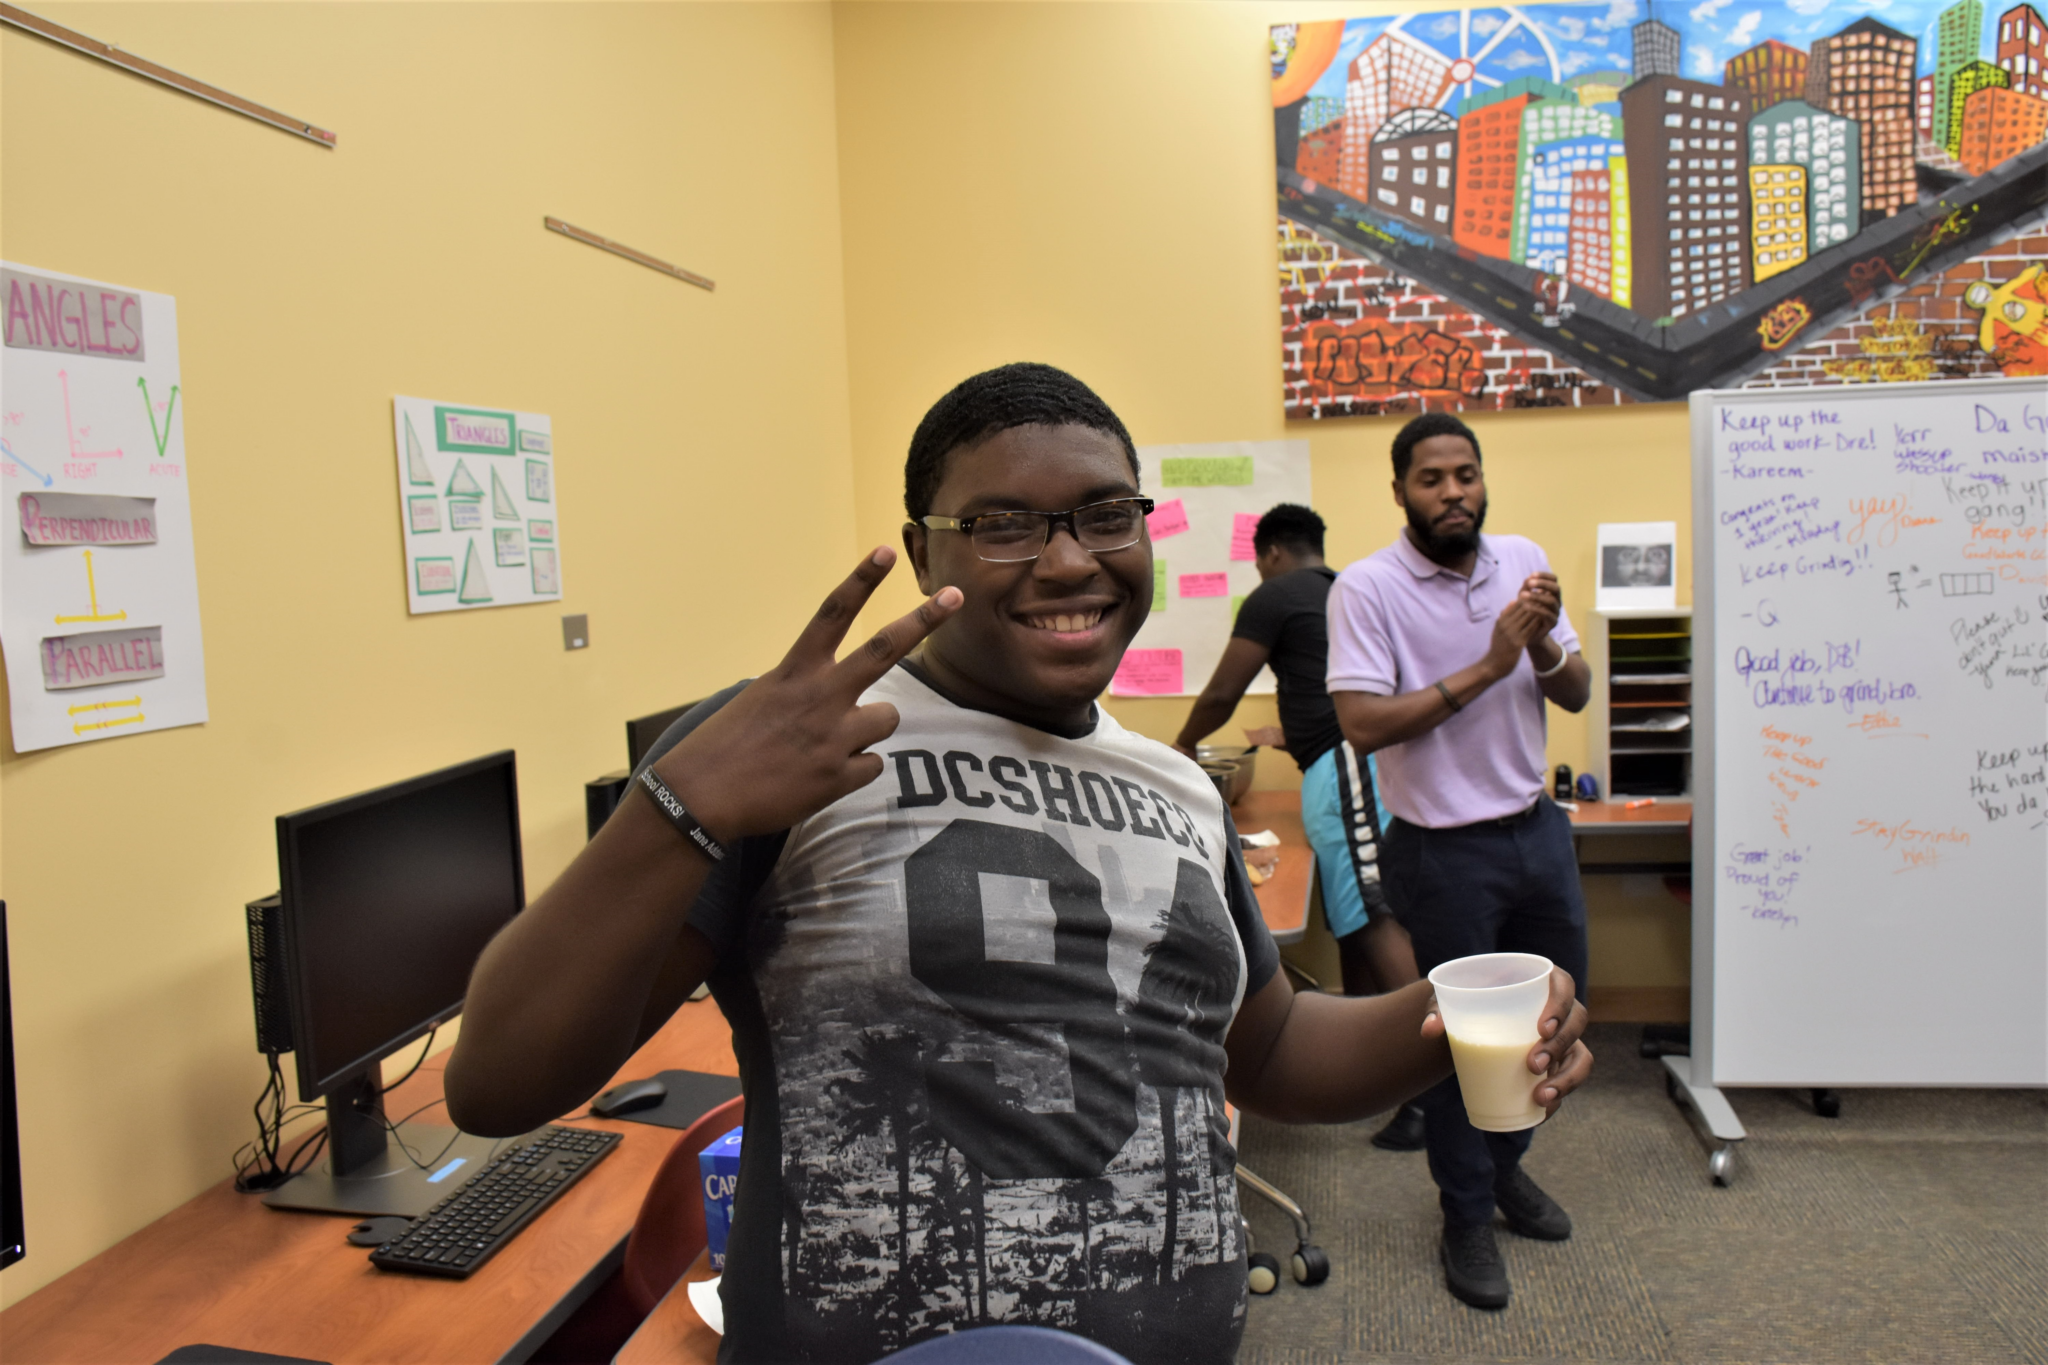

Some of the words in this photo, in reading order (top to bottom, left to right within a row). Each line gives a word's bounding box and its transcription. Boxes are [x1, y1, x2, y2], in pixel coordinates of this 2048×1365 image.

[7, 279, 141, 355] ANGLES
[1721, 407, 1771, 437] Keep
[1778, 415, 1804, 433] up
[1809, 409, 1842, 425] the
[1974, 403, 2010, 433] Da
[1728, 434, 1776, 463] good
[1783, 434, 1831, 451] work
[1836, 427, 1877, 452] Dre!
[63, 462, 98, 480] RIGHT
[149, 463, 182, 478] ACUTE
[1739, 562, 1789, 587] Keep
[1976, 749, 2020, 772] Keep
[655, 786, 686, 820] ROCKS!
[690, 826, 709, 847] Jane
